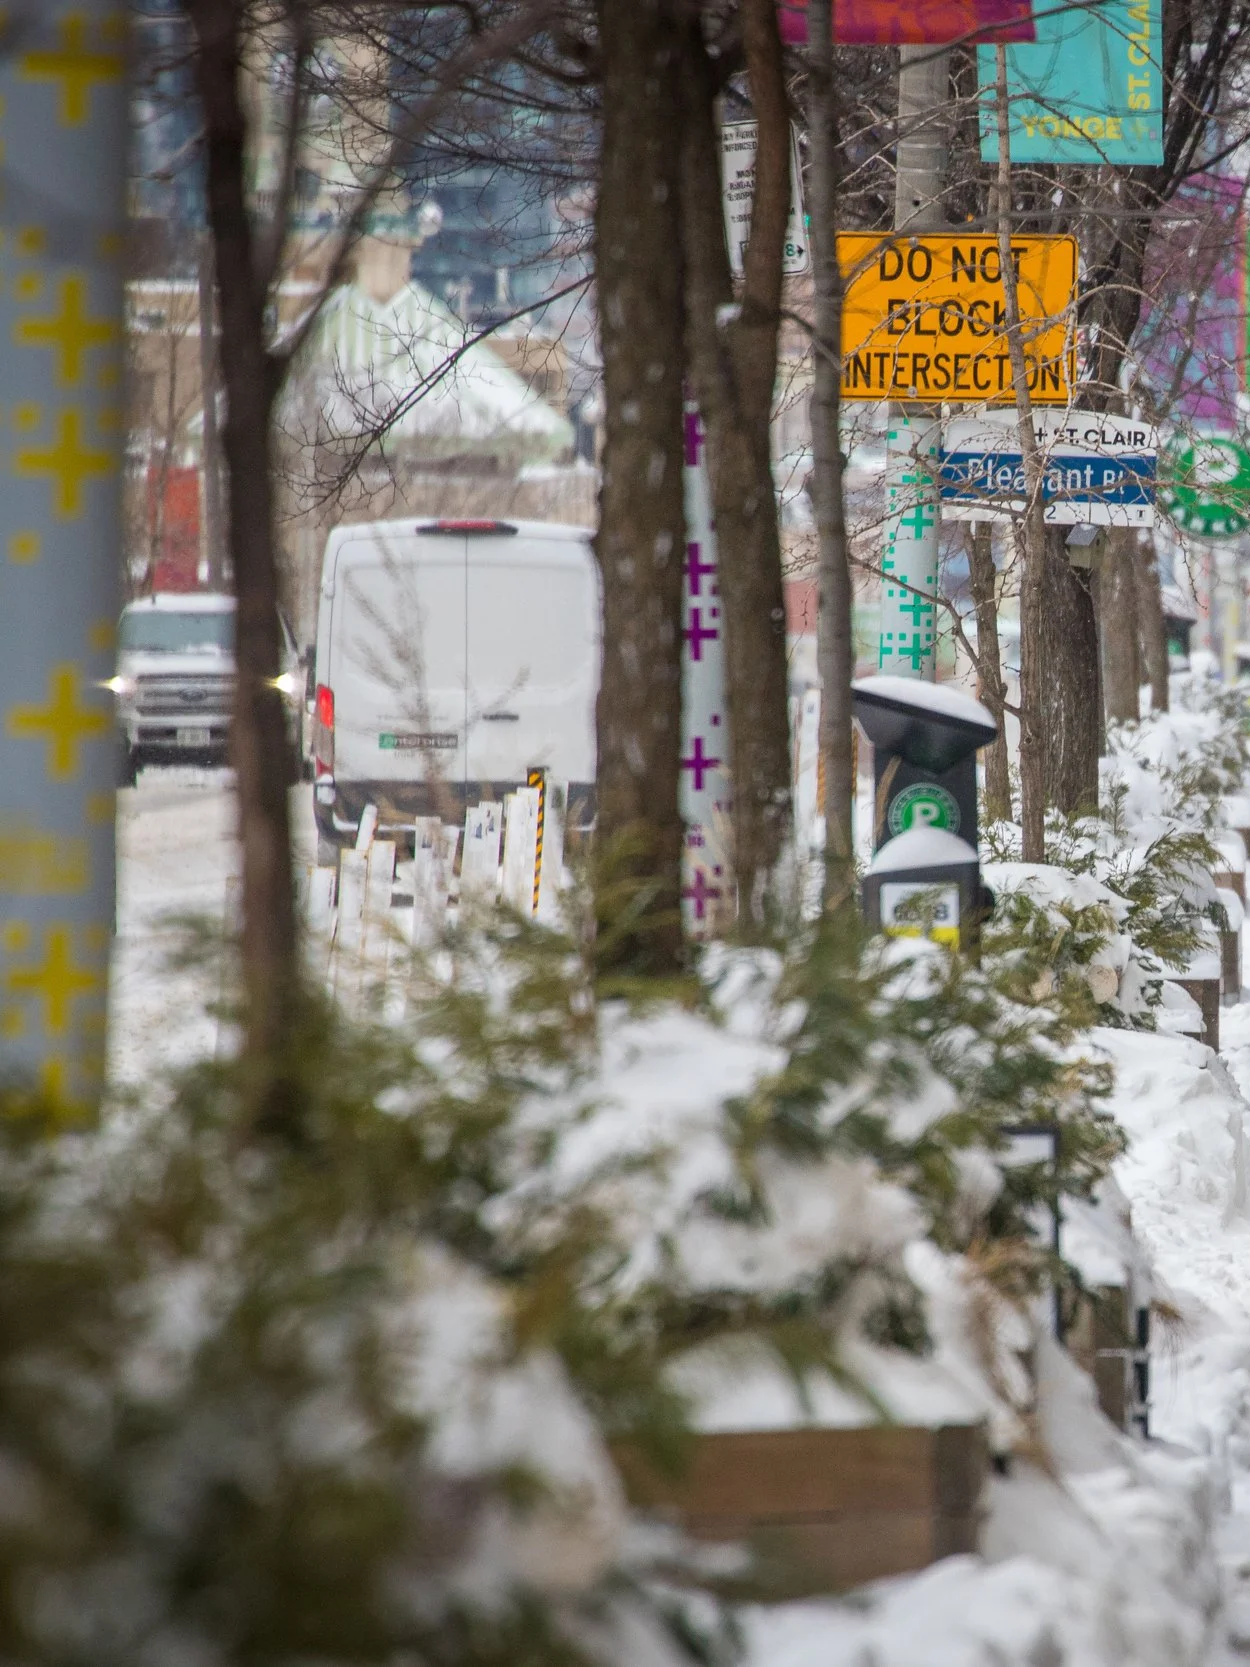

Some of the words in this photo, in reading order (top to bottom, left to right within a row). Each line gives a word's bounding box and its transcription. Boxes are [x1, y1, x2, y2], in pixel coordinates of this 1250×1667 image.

[1128, 72, 1150, 110] ST.
[1021, 115, 1122, 140] YONGE
[880, 244, 933, 282] DO
[952, 246, 1028, 283] NOT
[845, 352, 1061, 391] INTERSECTON
[1084, 428, 1147, 447] CLAIR
[968, 458, 1093, 493] Pleaant
